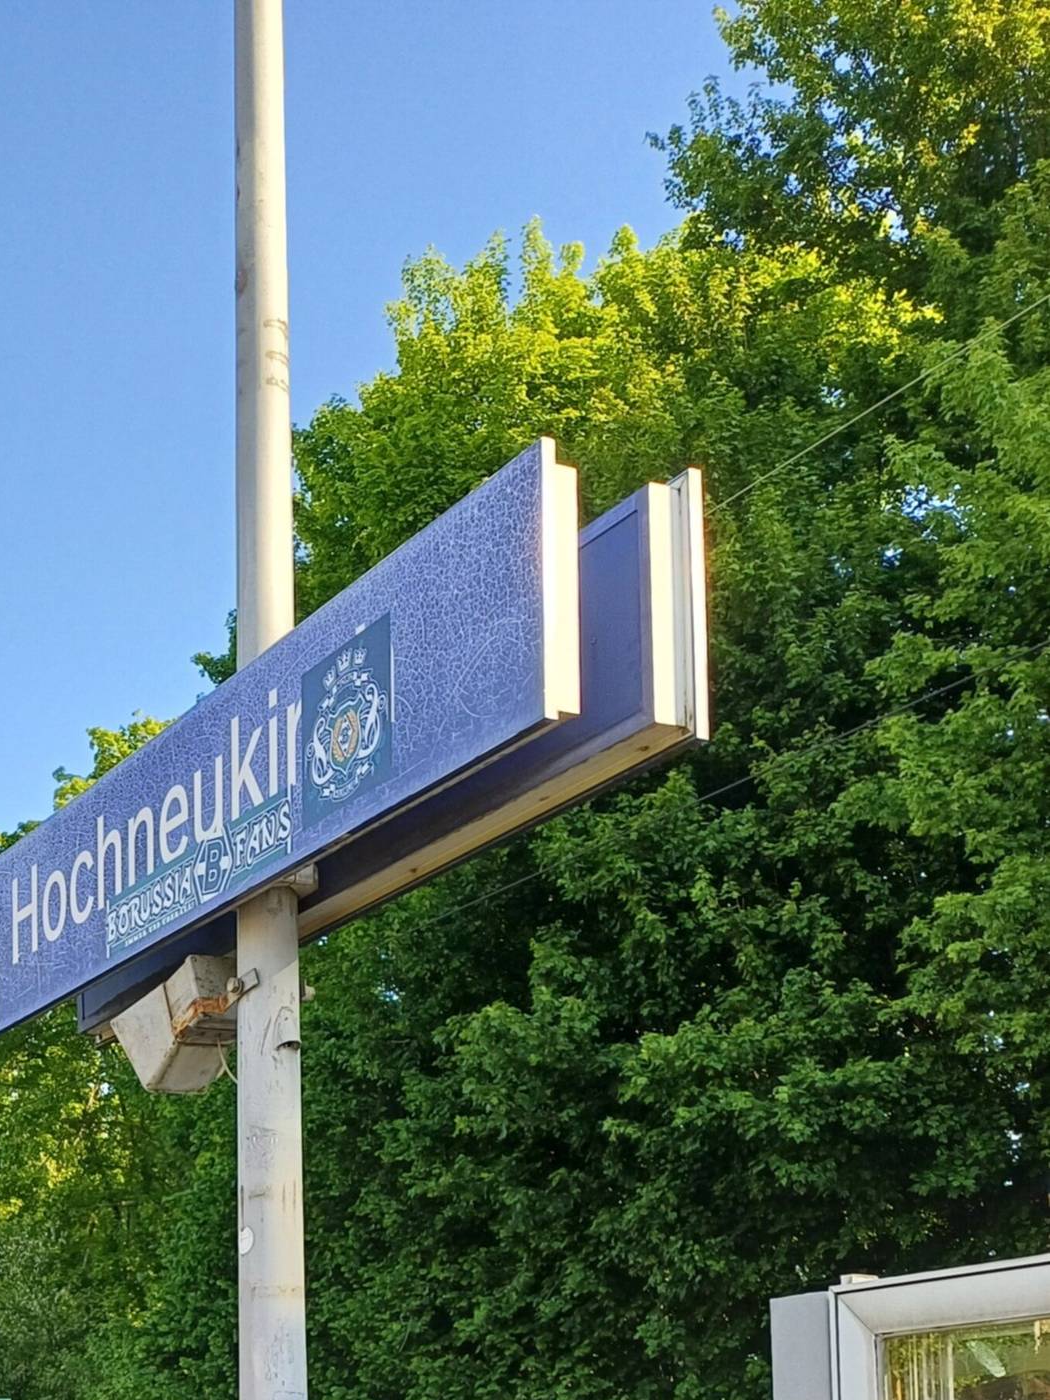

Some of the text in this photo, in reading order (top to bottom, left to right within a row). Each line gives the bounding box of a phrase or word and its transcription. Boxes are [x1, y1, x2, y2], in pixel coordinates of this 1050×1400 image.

[11, 622, 394, 965] Hochneukir
[107, 865, 193, 942] BORUSSIA
[233, 802, 292, 868] FANS
